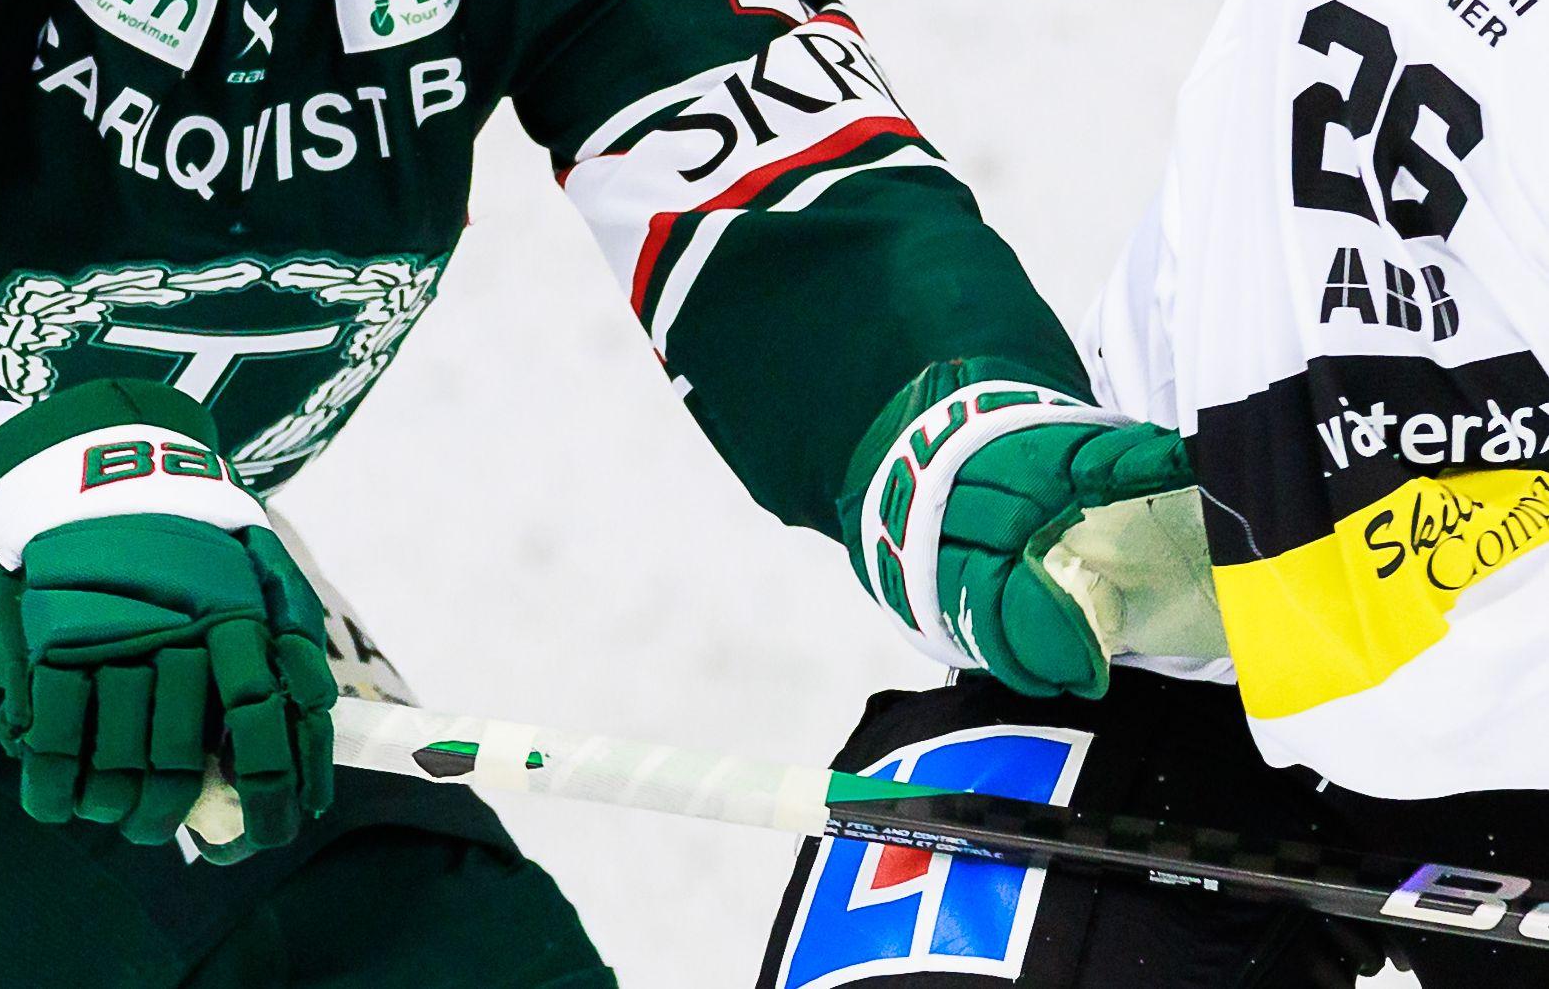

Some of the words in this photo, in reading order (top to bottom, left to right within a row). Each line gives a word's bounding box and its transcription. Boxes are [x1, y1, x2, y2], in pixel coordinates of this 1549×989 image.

[116, 10, 181, 49] workmate
[399, 7, 438, 26] Your
[1292, 0, 1484, 243] 26
[1320, 247, 1459, 342] ABB
